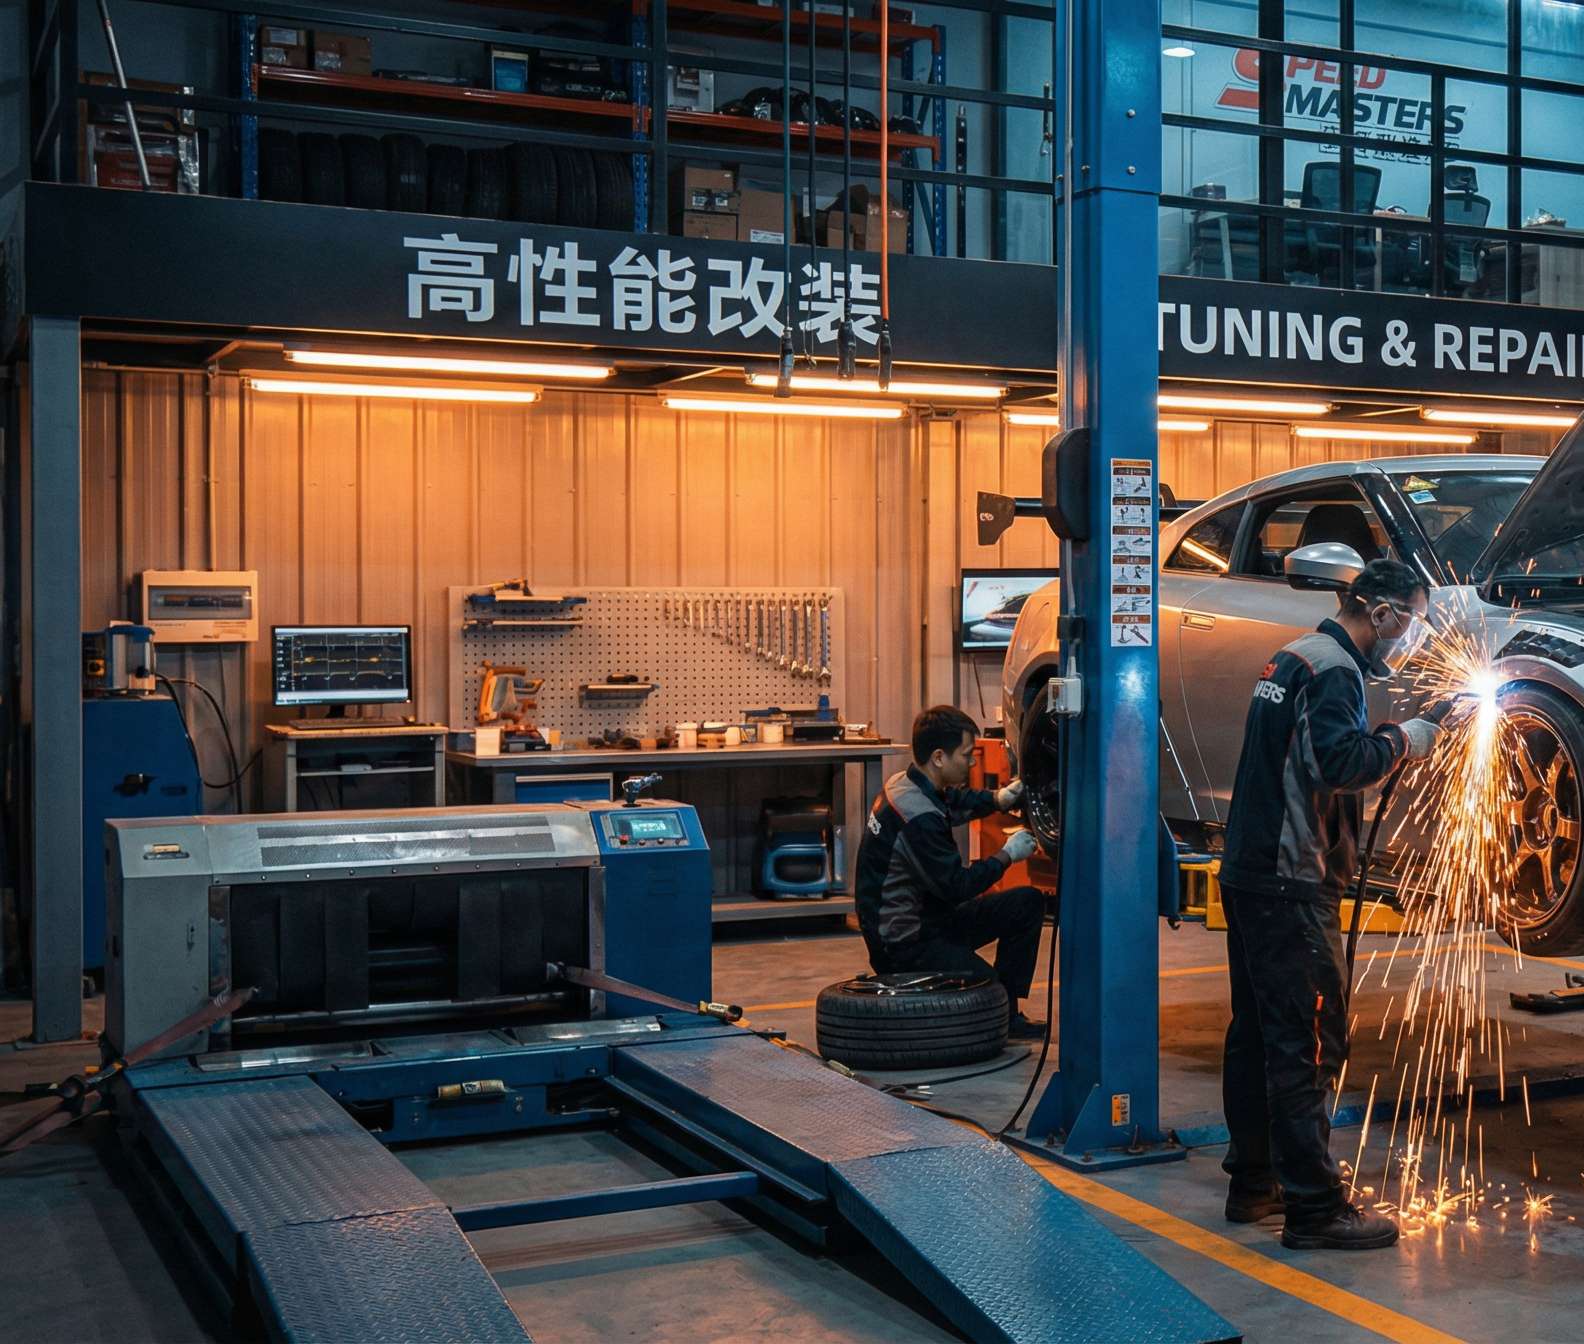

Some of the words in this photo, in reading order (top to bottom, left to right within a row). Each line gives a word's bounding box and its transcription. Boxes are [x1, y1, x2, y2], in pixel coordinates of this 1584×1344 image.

[403, 233, 881, 345] 高性能改装
[1380, 319, 1417, 368] &
